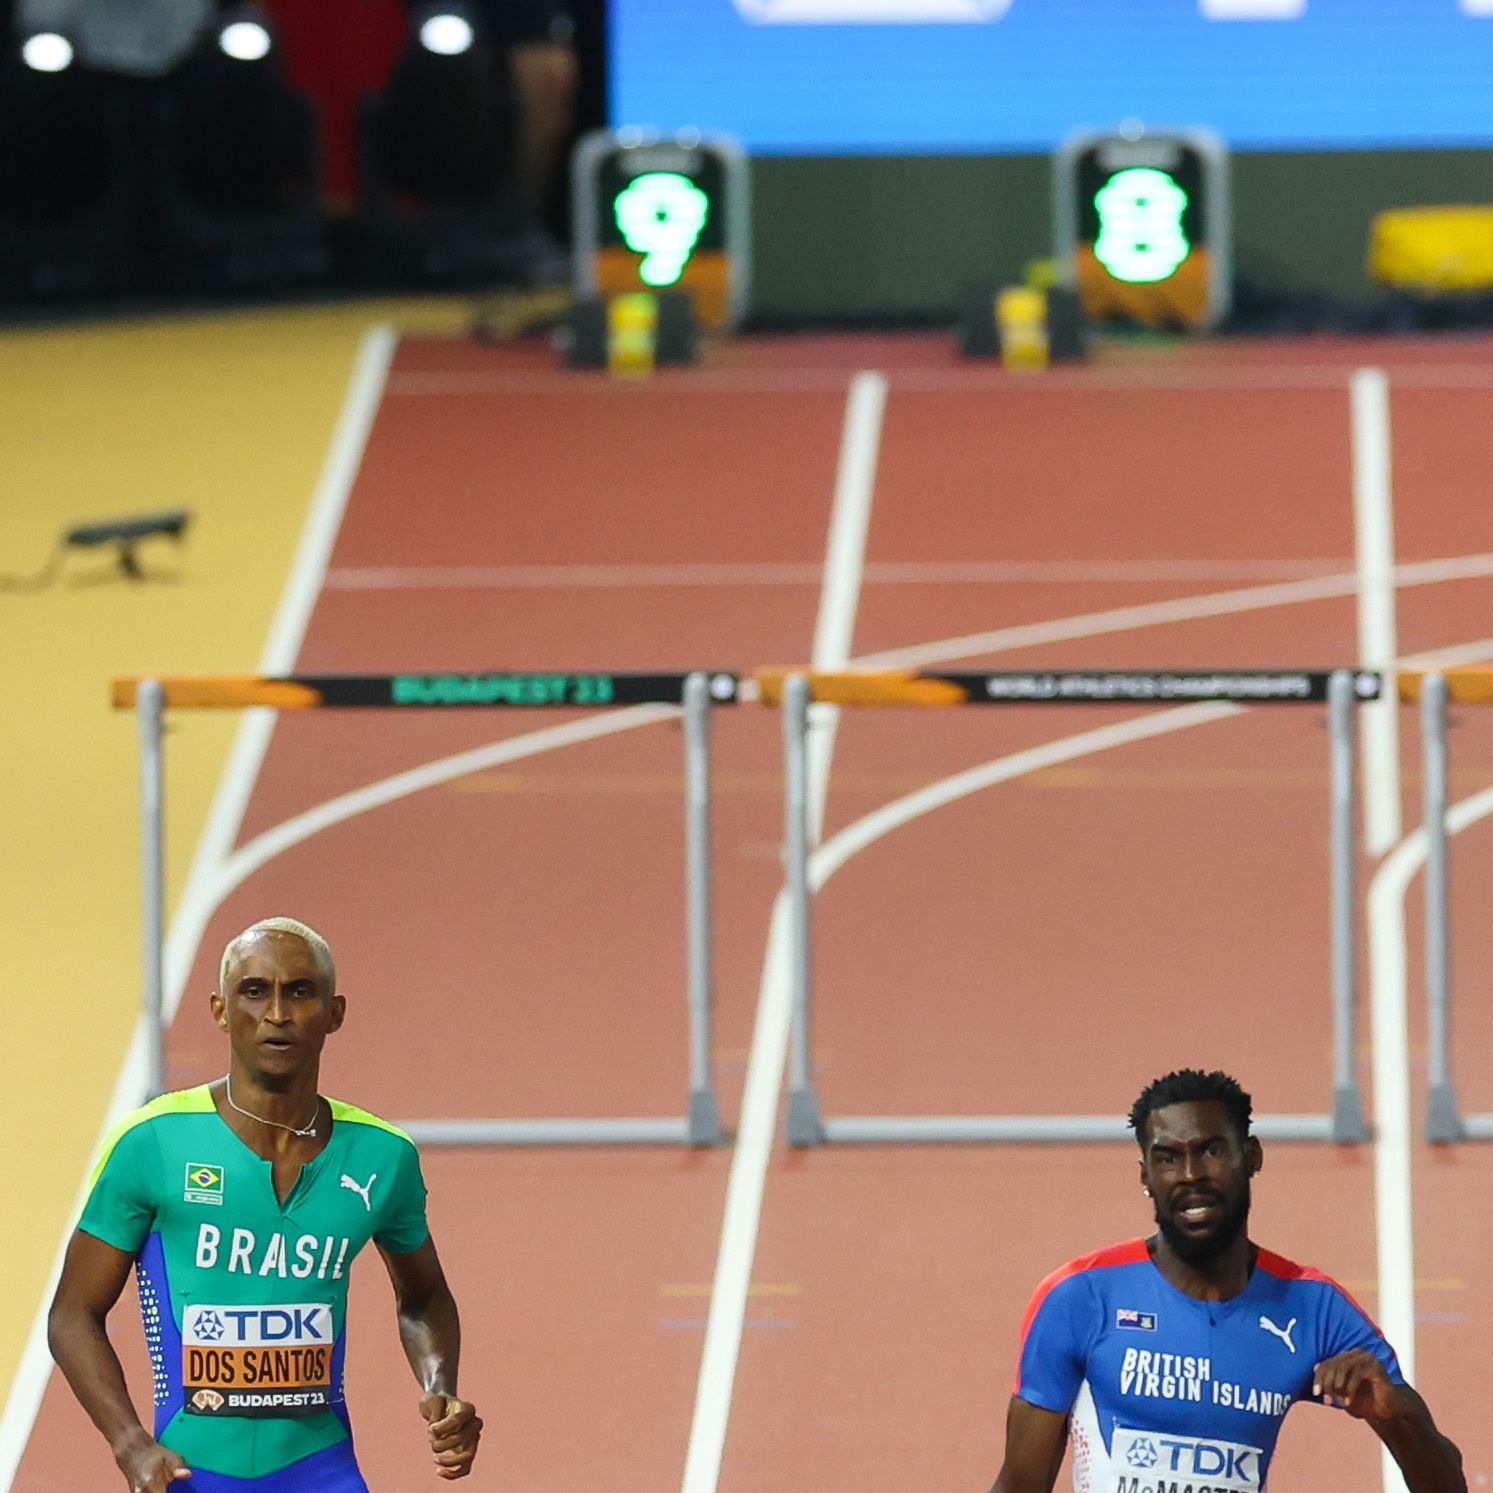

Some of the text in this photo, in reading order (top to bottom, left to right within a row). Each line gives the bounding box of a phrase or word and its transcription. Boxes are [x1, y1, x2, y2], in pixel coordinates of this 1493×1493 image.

[615, 171, 709, 287] 9
[1093, 166, 1190, 284] 8
[194, 1222, 349, 1281] BRASIL
[224, 1308, 321, 1340] TDK
[189, 1347, 325, 1384] DOS SANTOS
[1122, 1347, 1211, 1381] BRITISH
[228, 1392, 325, 1407] BUDAPEST 23
[1119, 1369, 1291, 1417] VIRGIN ISLANDS
[1160, 1439, 1251, 1482] TDK
